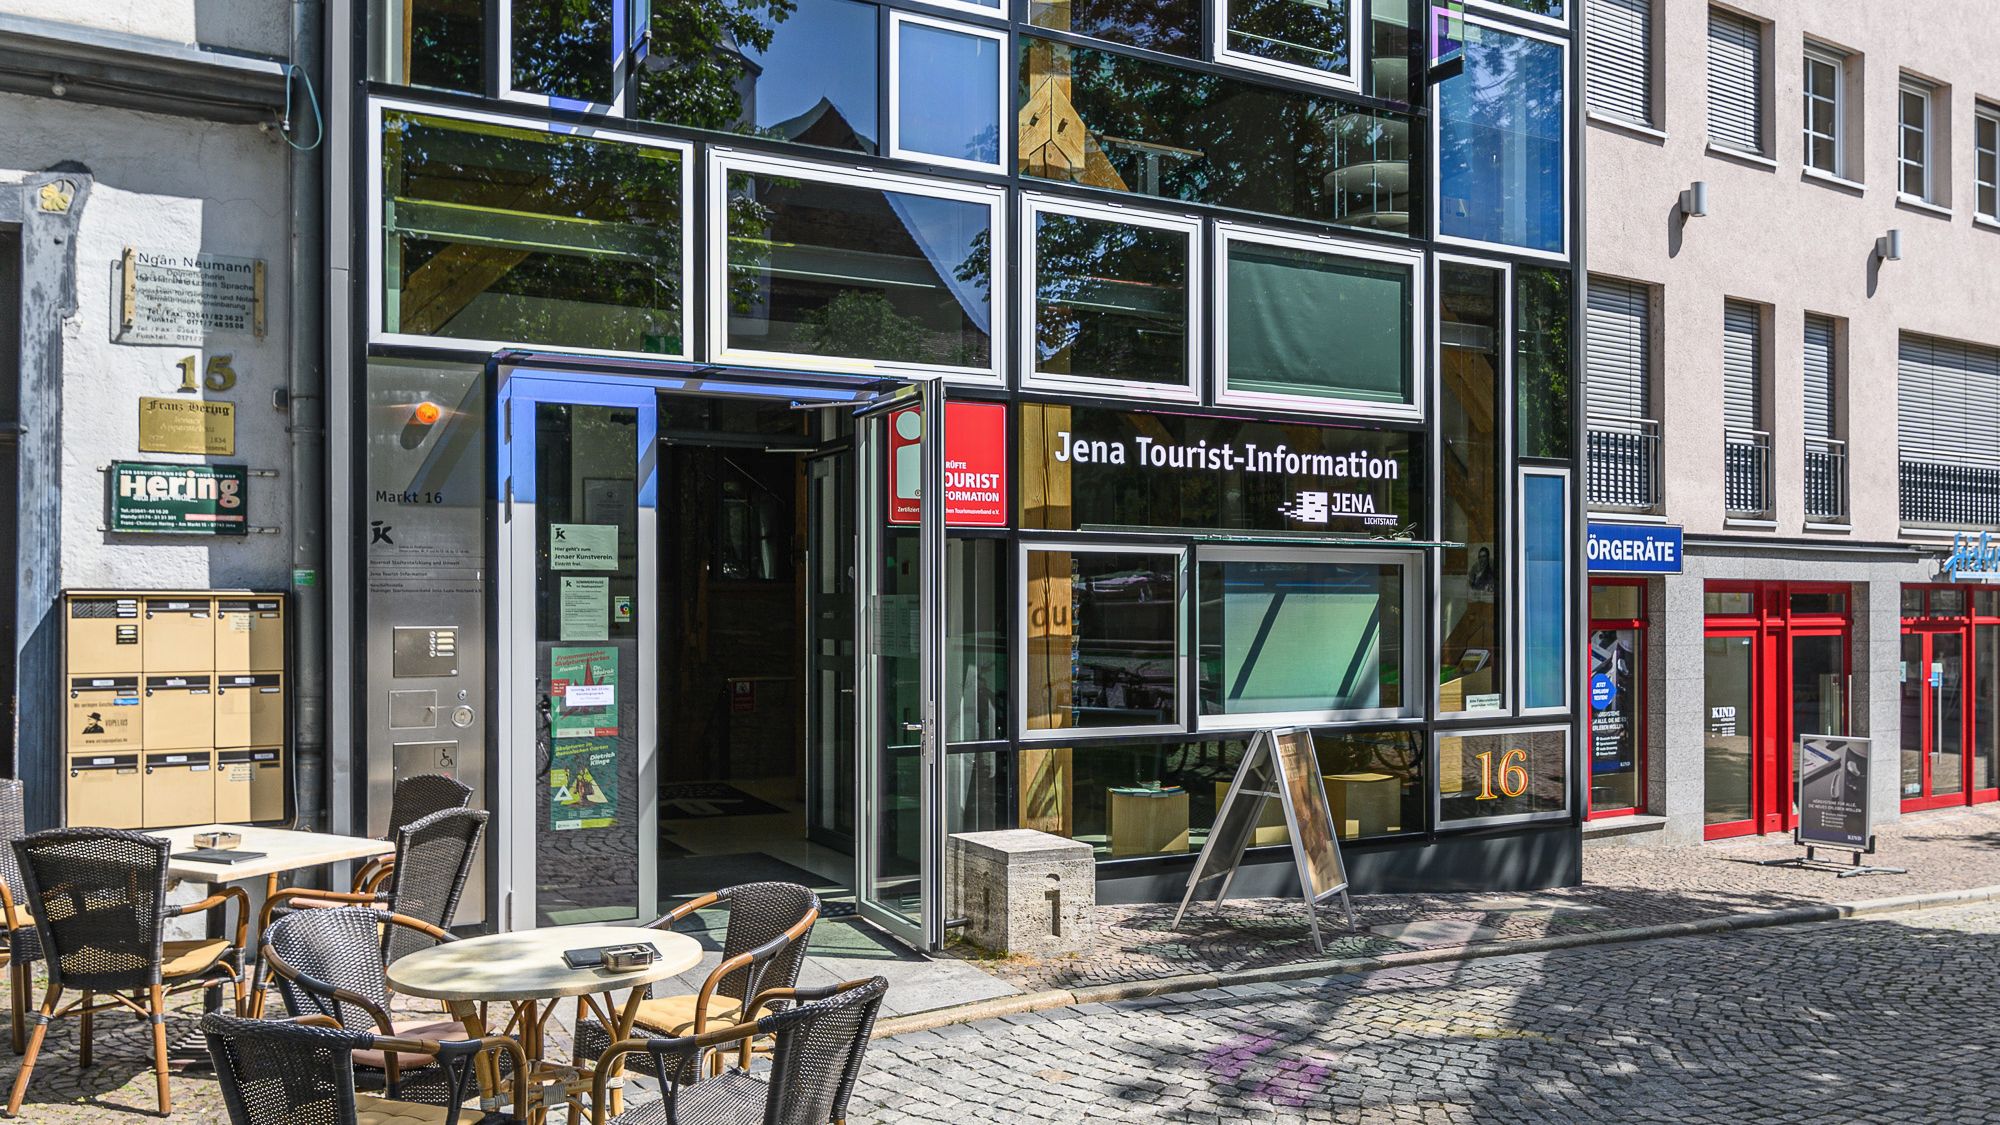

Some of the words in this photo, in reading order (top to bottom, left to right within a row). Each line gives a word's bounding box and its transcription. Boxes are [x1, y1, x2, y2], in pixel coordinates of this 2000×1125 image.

[183, 256, 252, 273] Neumann
[179, 354, 237, 391] 15
[146, 400, 184, 412] Franz
[188, 401, 230, 416] Hering
[1055, 432, 1125, 465] Jena
[1135, 436, 1398, 480] Tourist-Information
[946, 460, 967, 470] RÜFTE
[120, 470, 240, 508] Hering
[945, 472, 999, 489] OURIST
[376, 490, 418, 503] Markt
[425, 492, 443, 504] 16
[945, 490, 999, 502] FORMATION
[1331, 492, 1375, 514] JENA
[1587, 533, 1675, 562] ÖRGERÄTE
[1712, 706, 1736, 719] KIND
[590, 752, 616, 761] Dietrich
[1475, 748, 1529, 801] 16
